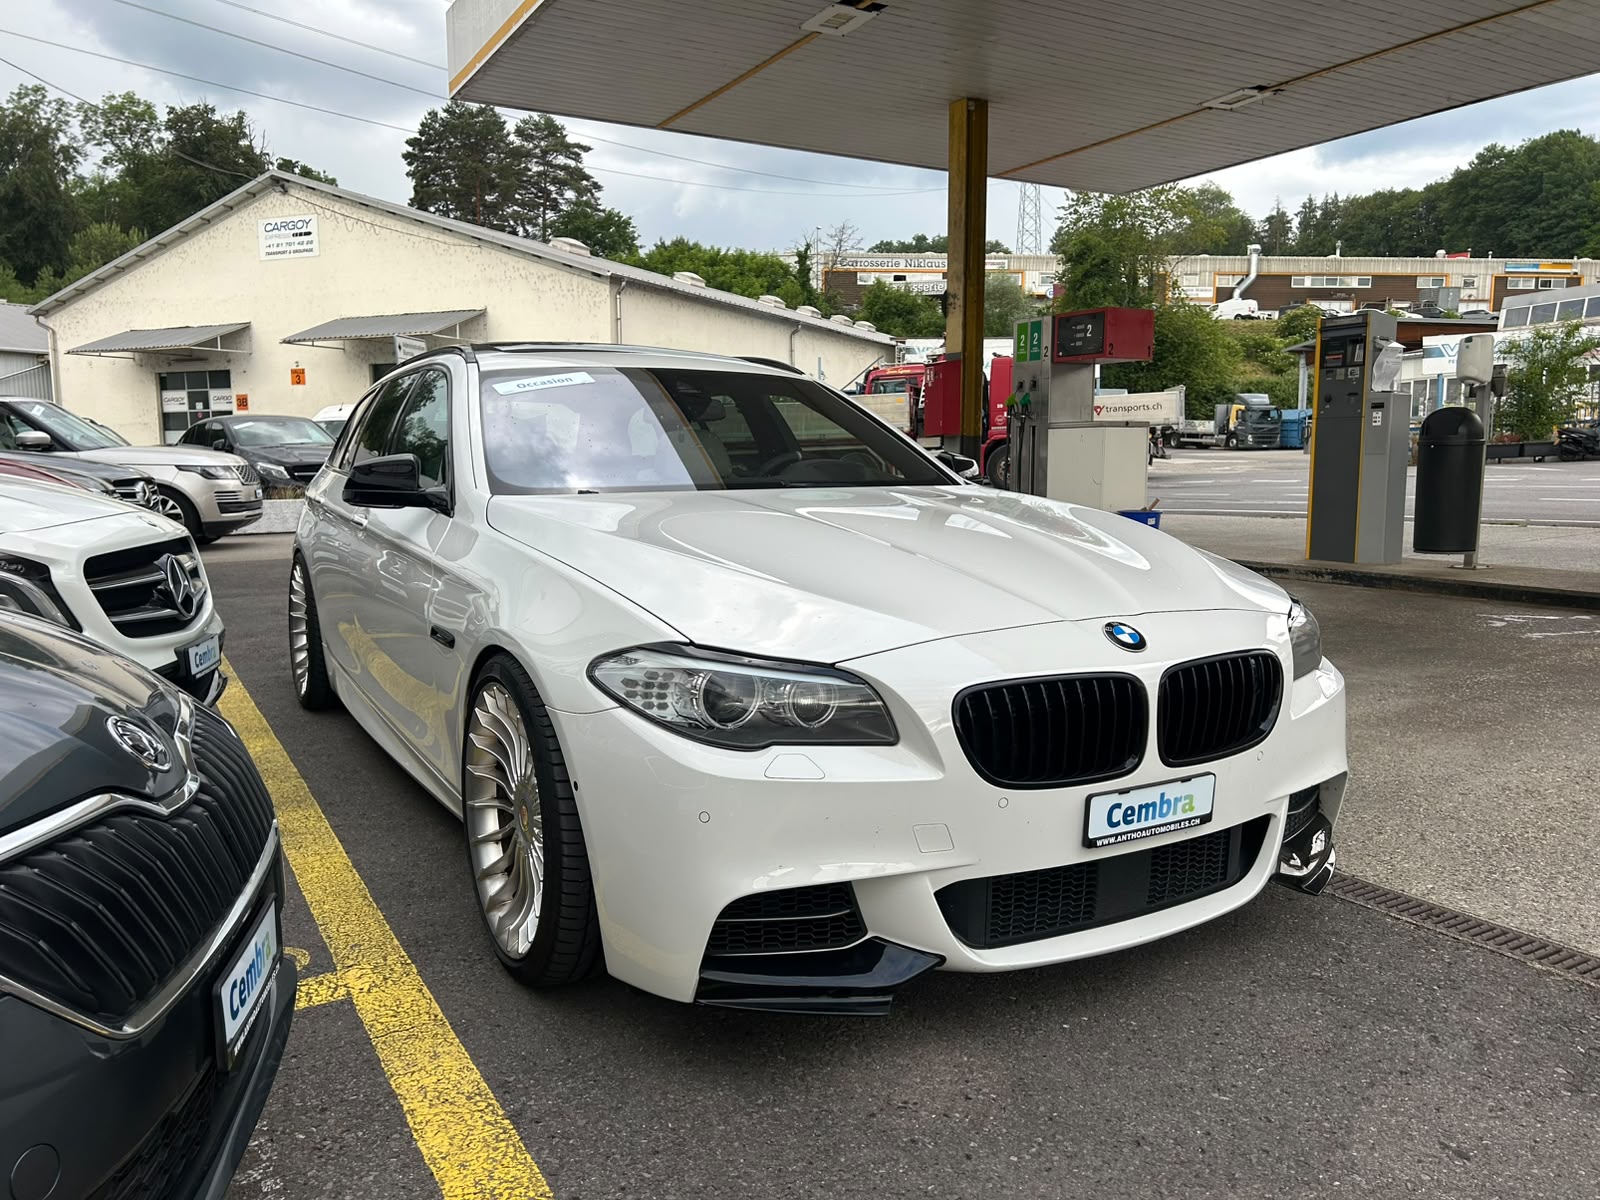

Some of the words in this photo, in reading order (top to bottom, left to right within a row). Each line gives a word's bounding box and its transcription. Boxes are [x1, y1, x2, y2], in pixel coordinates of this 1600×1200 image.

[264, 218, 312, 233] CARGOY
[839, 257, 901, 268] Carrosserie
[904, 257, 947, 268] Niklaus
[1086, 324, 1092, 337] 2
[1020, 334, 1025, 347] 2
[1033, 332, 1038, 345] 2
[1043, 346, 1049, 358] 2
[1108, 343, 1114, 355] 2
[295, 374, 302, 385] 3
[516, 377, 574, 389] Occasion
[236, 398, 248, 408] 3B
[1105, 402, 1163, 414] transports.ch
[194, 644, 217, 668] Cembra
[1106, 791, 1196, 829] Cembra
[1096, 818, 1201, 847] WWW.ANTHOAUTOMOBILES.CH
[229, 931, 272, 1021] Cembra
